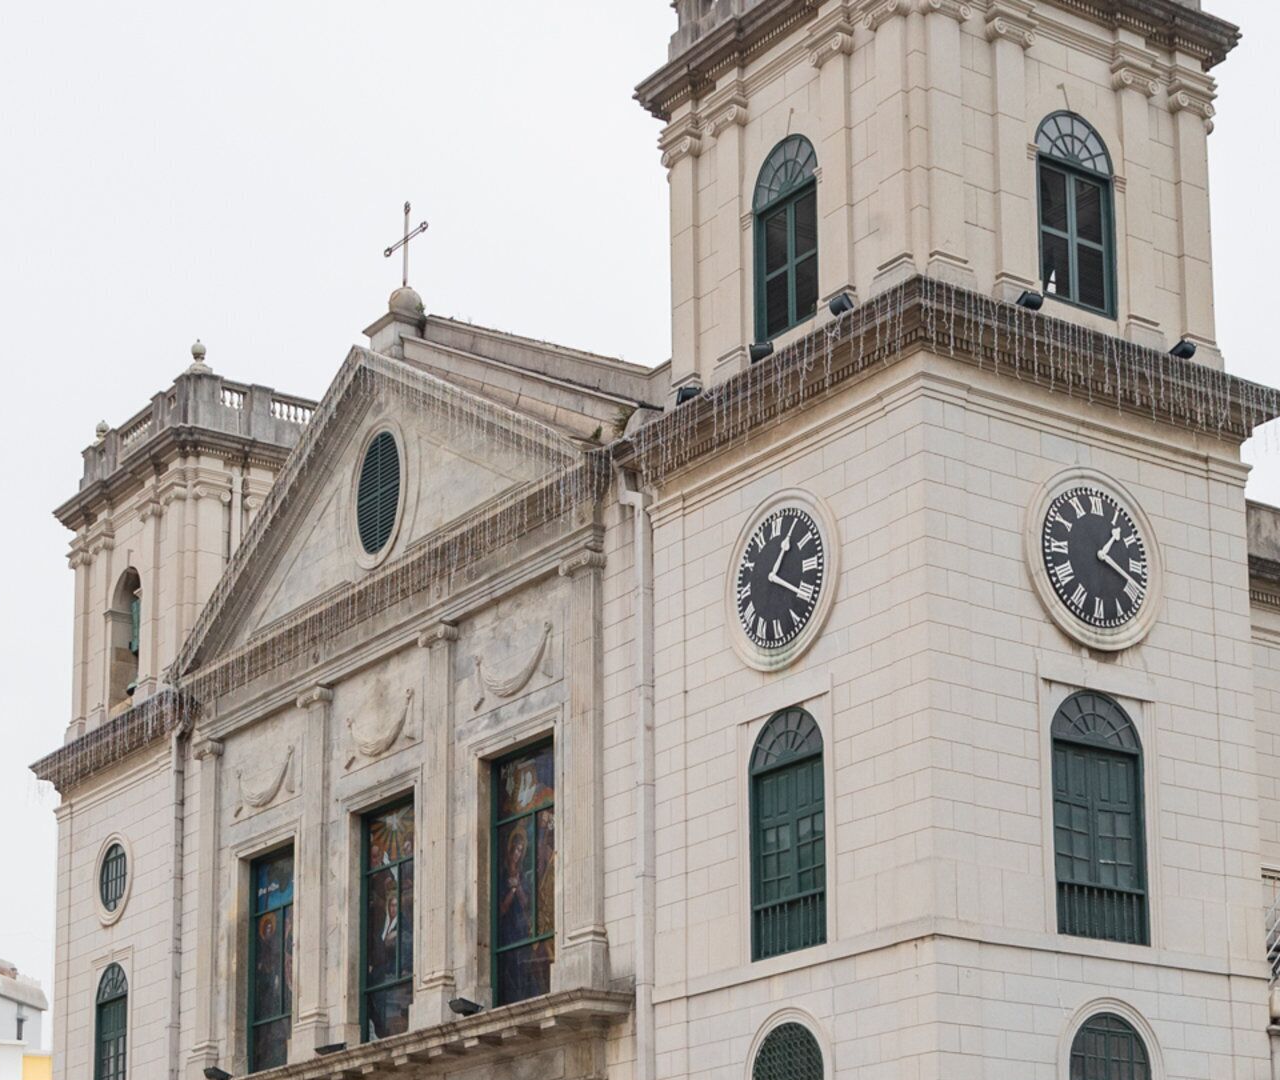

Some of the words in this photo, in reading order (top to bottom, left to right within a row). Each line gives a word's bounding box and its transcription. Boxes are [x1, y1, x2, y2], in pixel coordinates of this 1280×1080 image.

[1089, 496, 1104, 517] XII
[1055, 513, 1073, 533] X
[797, 531, 814, 550] II
[1123, 534, 1137, 549] II
[802, 556, 818, 572] III
[1129, 558, 1143, 575] III
